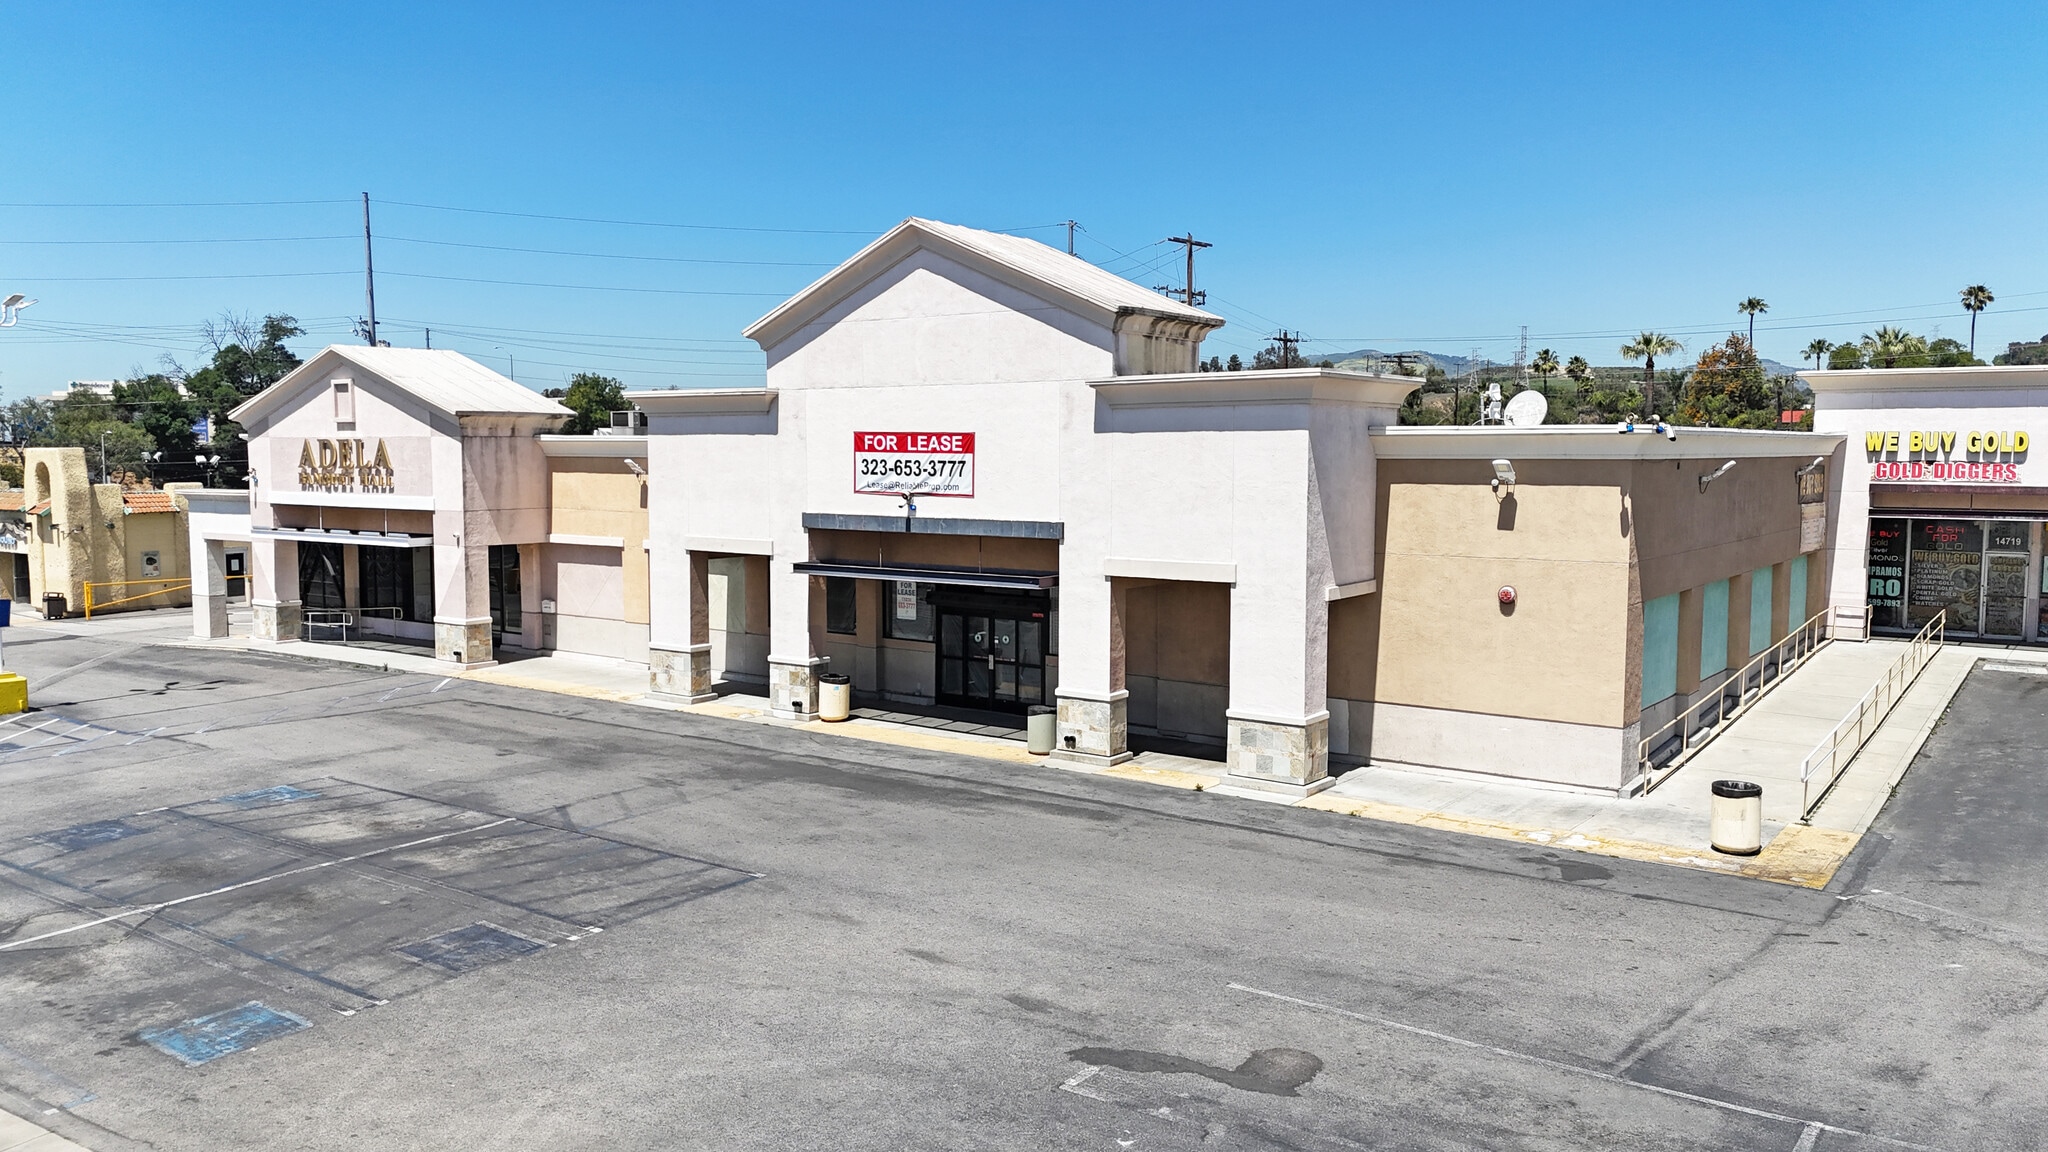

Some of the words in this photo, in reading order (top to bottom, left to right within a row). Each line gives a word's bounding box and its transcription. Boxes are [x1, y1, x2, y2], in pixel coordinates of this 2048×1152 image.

[864, 435, 898, 450] FOR
[907, 435, 963, 451] LEASE
[1866, 431, 1899, 452] WE
[1909, 431, 1956, 453] BUY
[1967, 431, 2029, 453] GOLD
[298, 438, 393, 468] ADELA
[861, 459, 966, 477] 323-653-3777
[1876, 462, 1923, 479] GOLD
[1933, 462, 2017, 480] DIGGERS
[360, 474, 394, 488] HALL
[1926, 525, 1965, 534] CASH
[1870, 538, 1889, 546] Gold
[1932, 534, 1958, 542] FOR
[1995, 537, 2022, 546] 14719
[1914, 551, 1930, 561] WE
[1931, 552, 1951, 563] BUY
[1953, 553, 1979, 564] GOLD
[898, 588, 916, 596] LEASE
